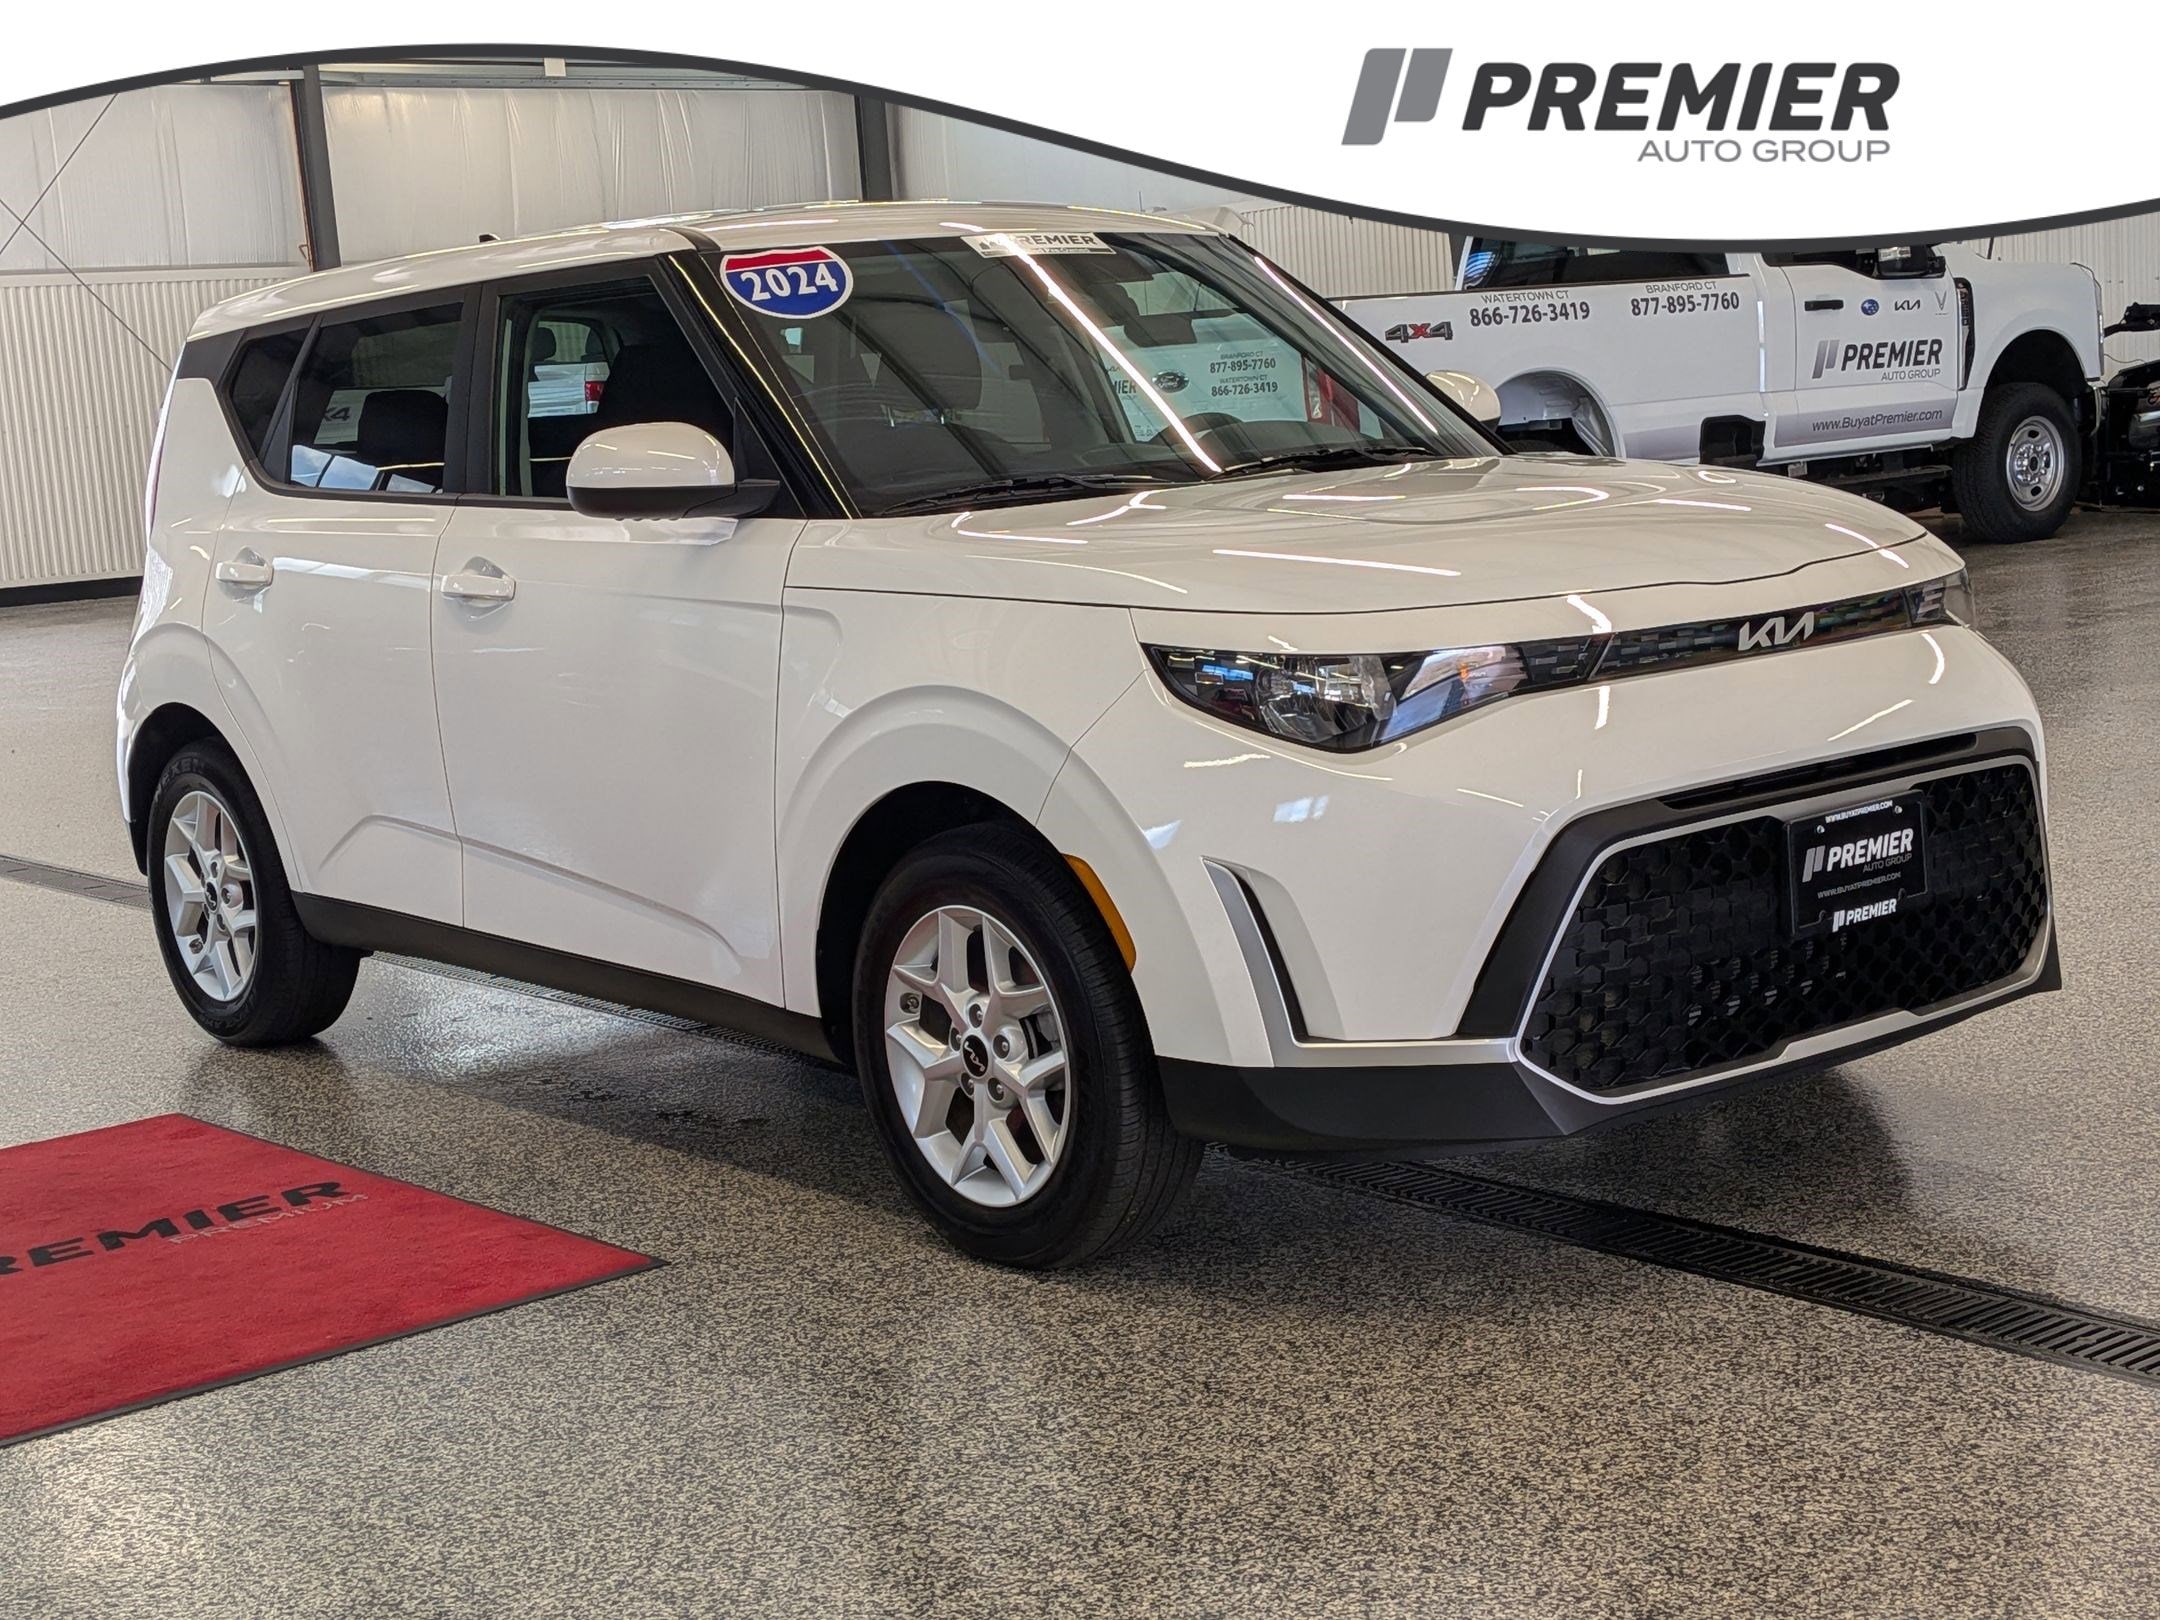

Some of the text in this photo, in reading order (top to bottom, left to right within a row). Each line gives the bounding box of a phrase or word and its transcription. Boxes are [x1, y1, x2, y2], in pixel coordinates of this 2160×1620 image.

[1014, 234, 1096, 246] REMIER
[740, 263, 838, 301] 2024
[1646, 280, 1717, 294] BRANFORD CT
[1481, 289, 1569, 304] WATERTOWN CT
[1631, 291, 1740, 317] 877-895-7760
[1470, 301, 1591, 327] 866-726-3419
[1210, 358, 1276, 373] 877-895-7760
[1841, 338, 1943, 371] PREMIER
[1881, 368, 1941, 381] AUTO GROUP
[1211, 381, 1278, 397] 866-726-3419
[1812, 409, 1943, 432] www.BuyatPremier.com
[1738, 611, 1814, 651] KIA
[1825, 800, 1893, 824] WWW.BUYATPREMIER.COM
[1826, 828, 1914, 872] PREMIER
[1863, 853, 1912, 873] AUTO GROUP
[1817, 872, 1901, 899] WWW.BUYATPREMIER.COM
[1845, 899, 1897, 926] PREMIER
[0, 1182, 350, 1276] EMIER
